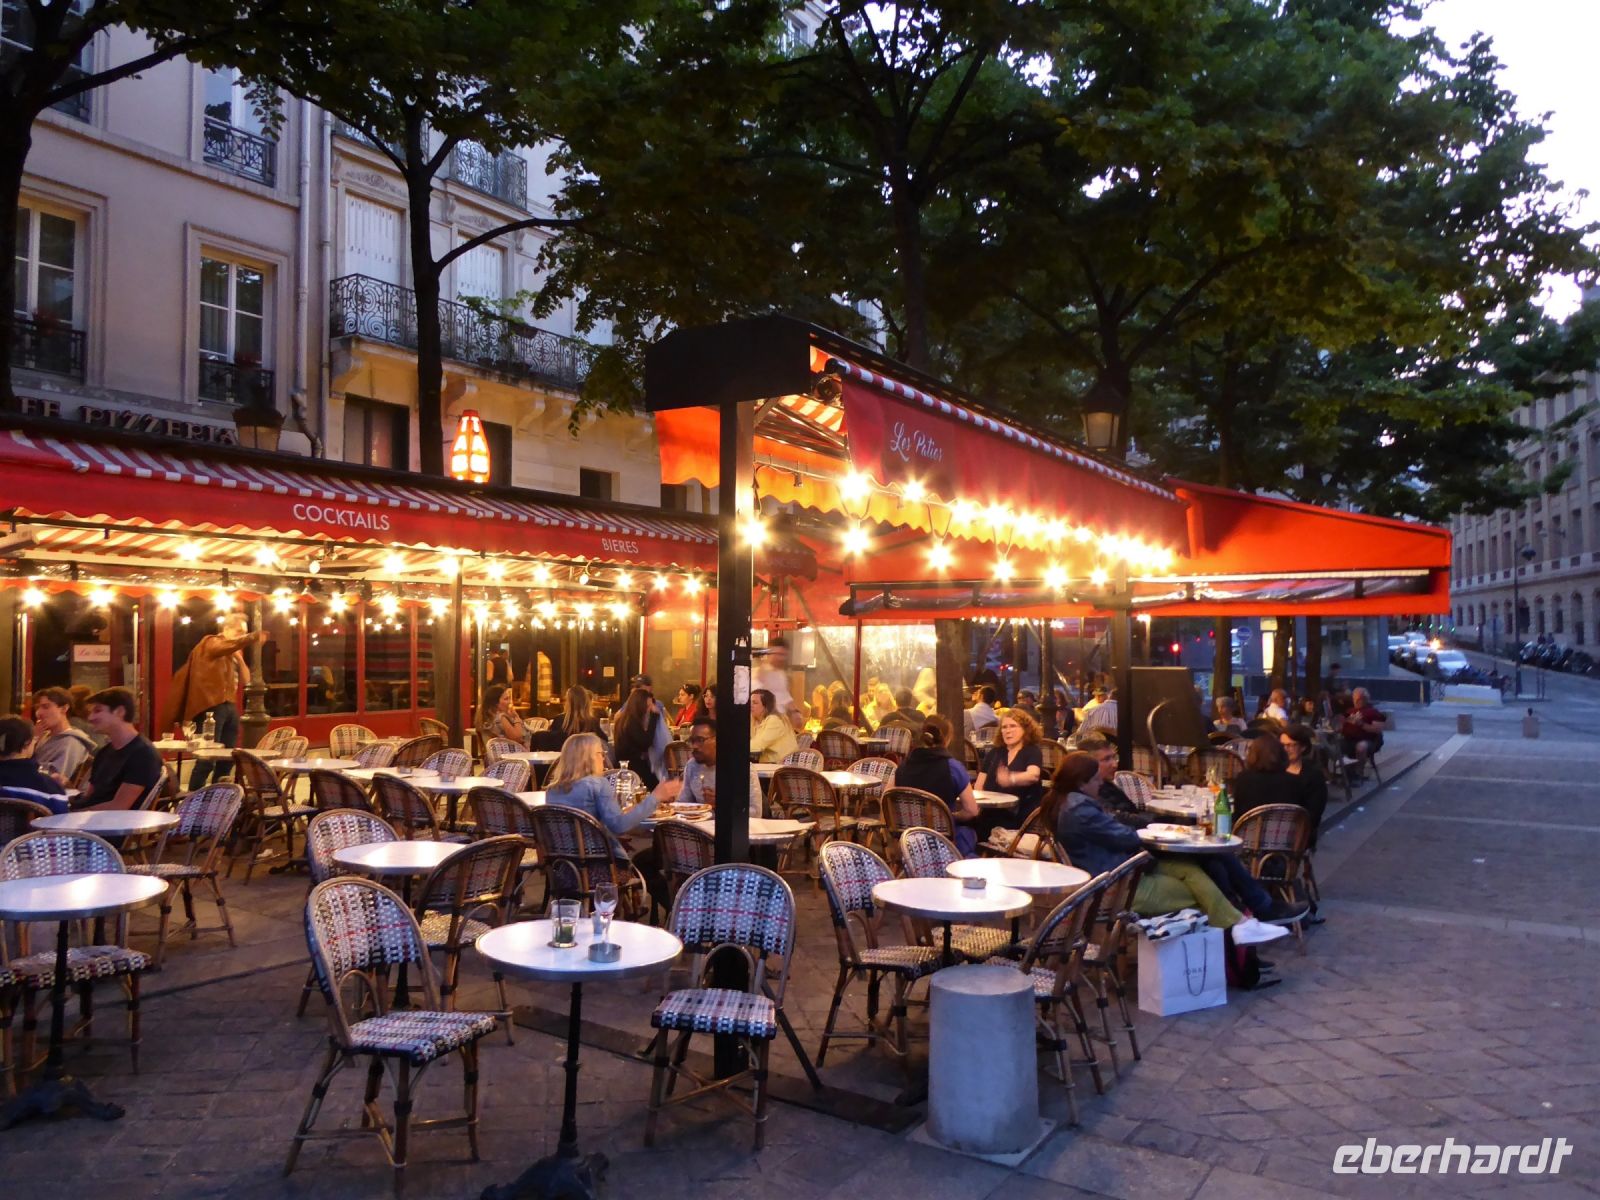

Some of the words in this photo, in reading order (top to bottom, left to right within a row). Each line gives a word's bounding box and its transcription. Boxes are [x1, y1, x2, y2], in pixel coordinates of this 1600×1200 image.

[79, 405, 239, 445] PIZZERIA
[293, 503, 390, 531] COCKTAILS
[601, 537, 639, 554] BIERES
